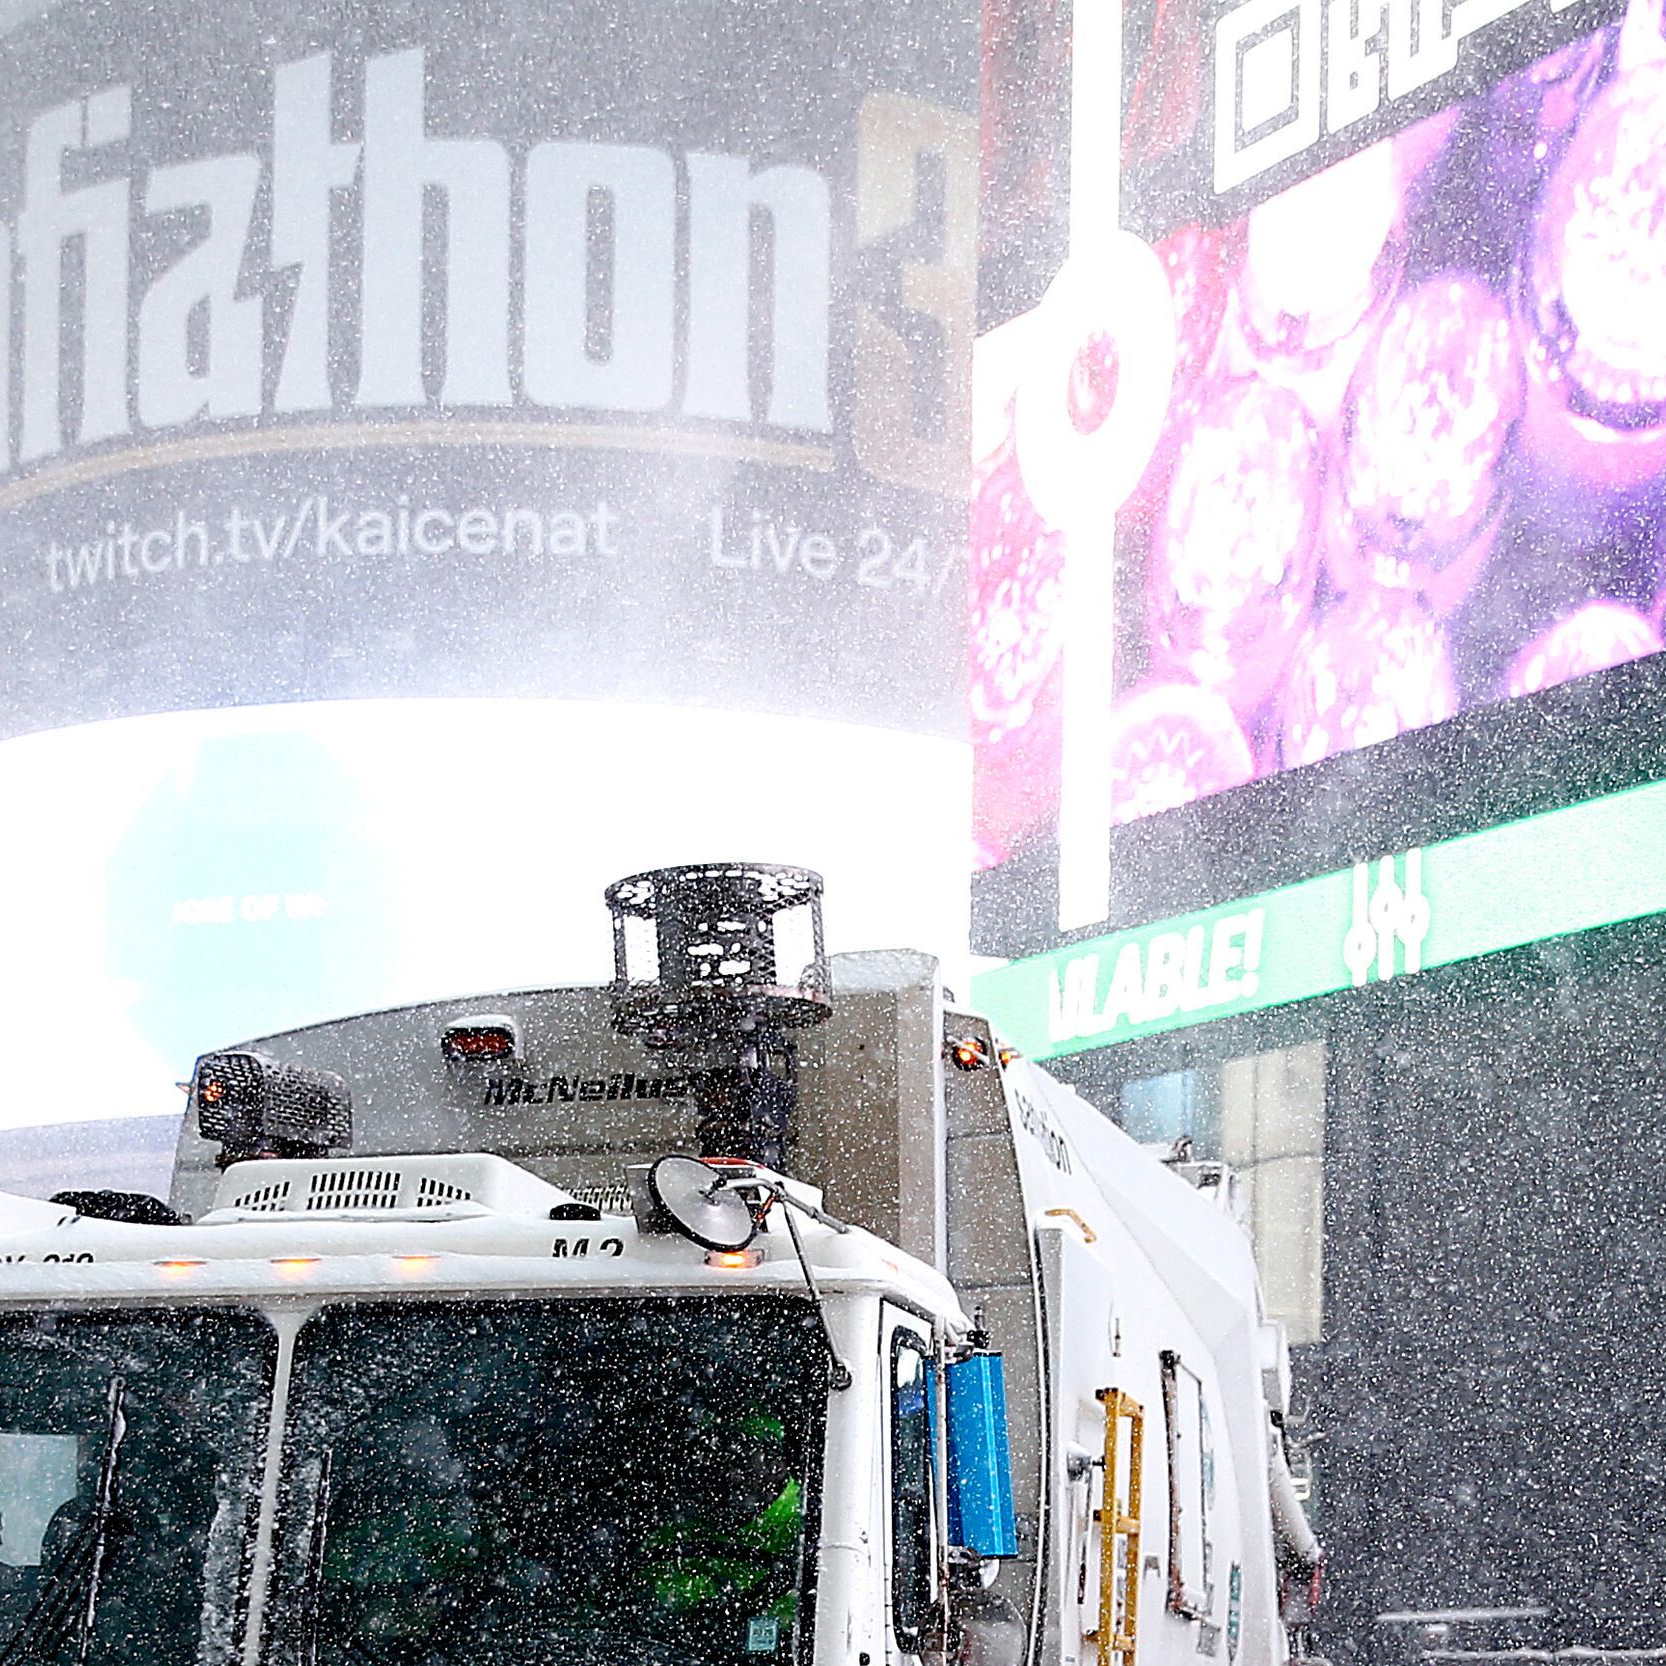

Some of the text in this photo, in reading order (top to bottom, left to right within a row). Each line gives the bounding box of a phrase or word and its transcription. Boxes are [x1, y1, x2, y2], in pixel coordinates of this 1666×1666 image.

[45, 492, 620, 592] twitch.tv/kaicenat
[709, 506, 839, 578] Live
[483, 1072, 686, 1106] McNeilus
